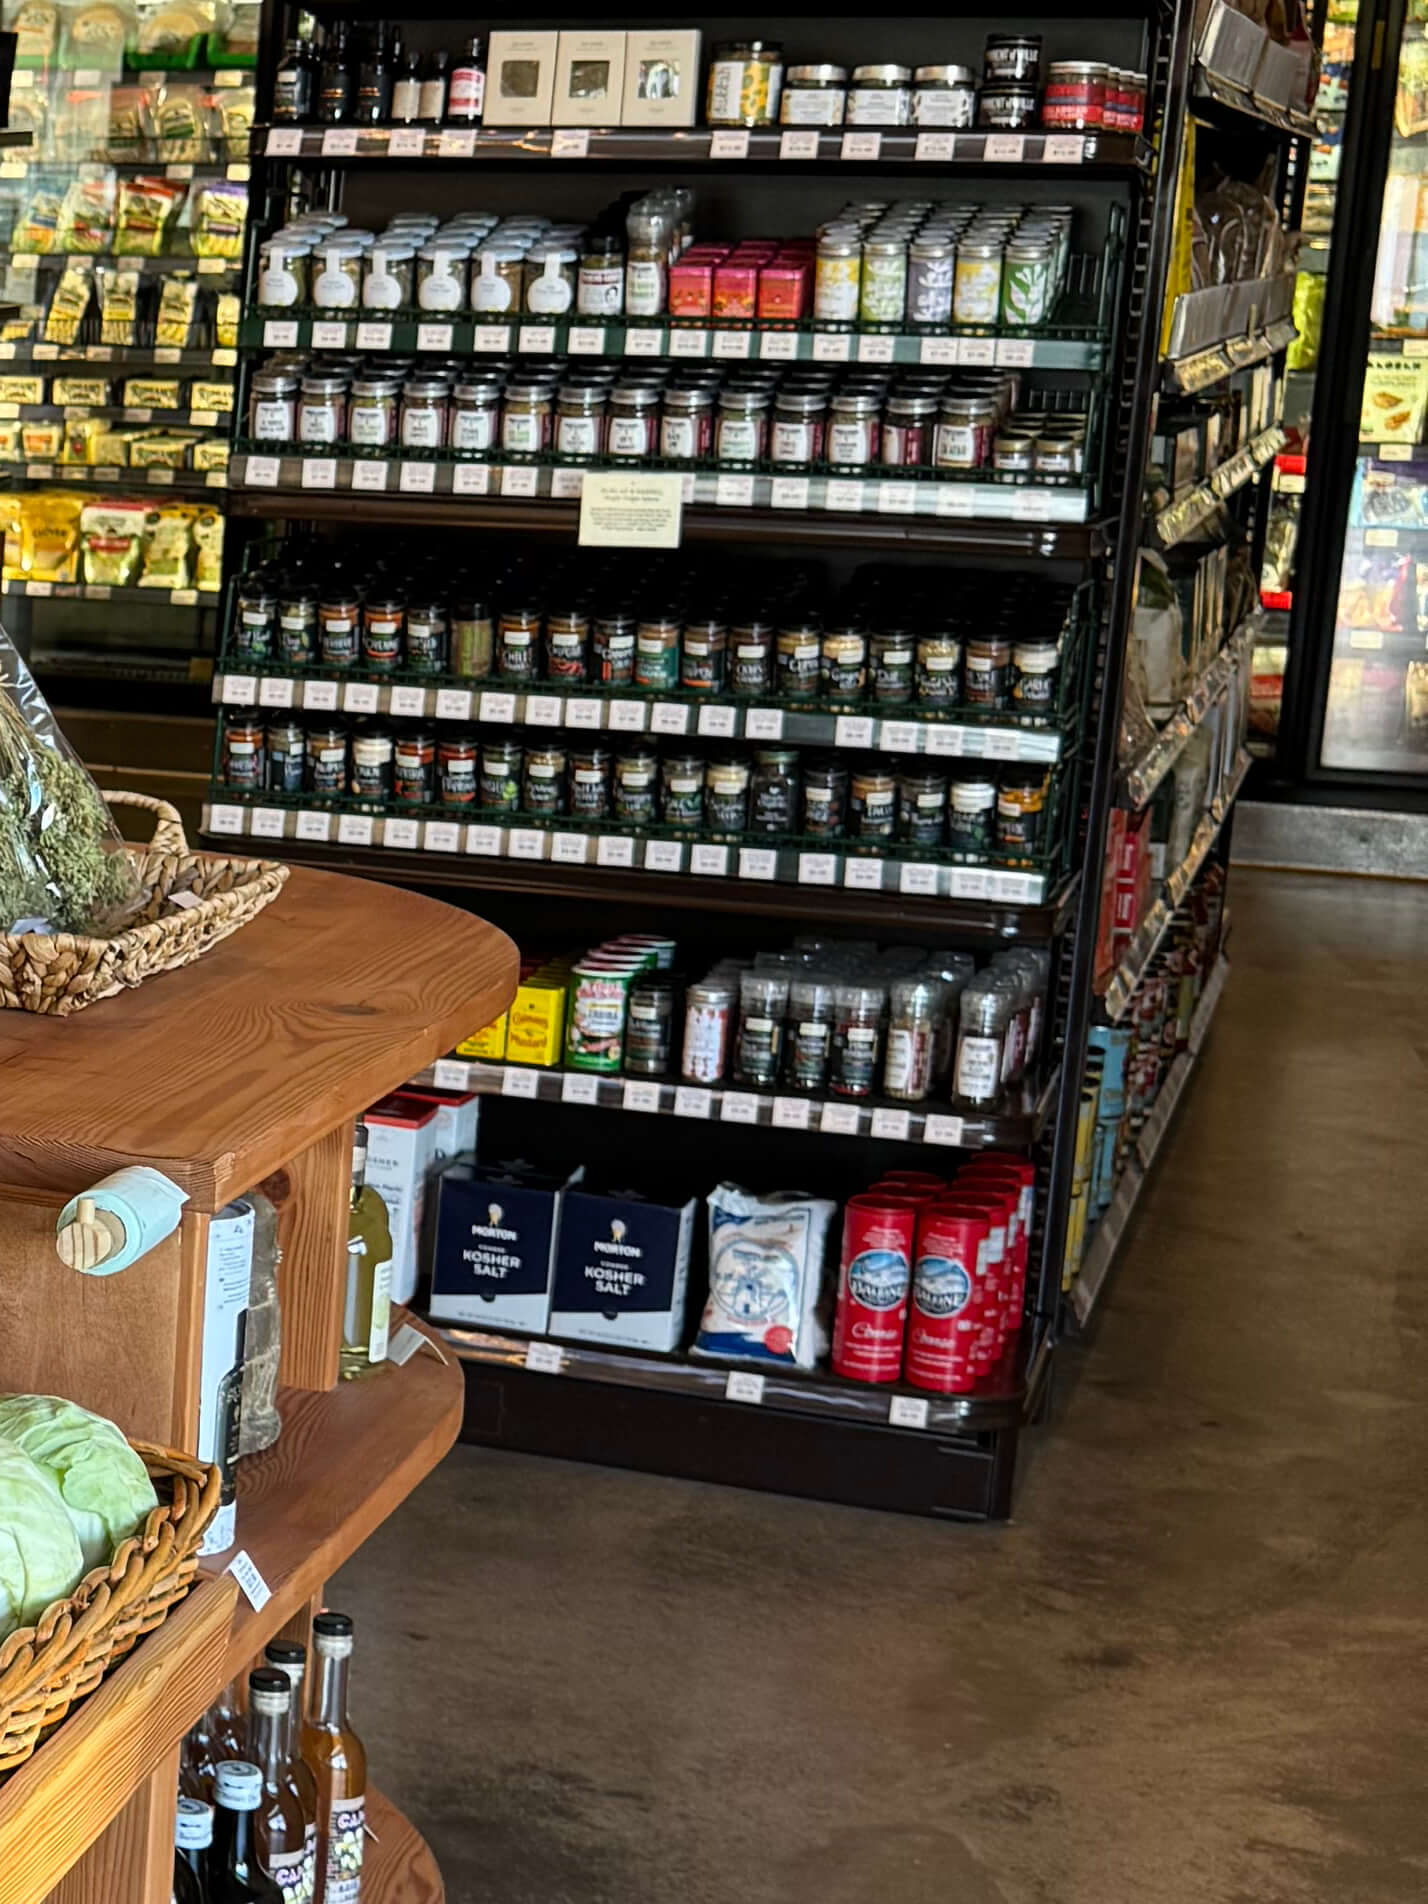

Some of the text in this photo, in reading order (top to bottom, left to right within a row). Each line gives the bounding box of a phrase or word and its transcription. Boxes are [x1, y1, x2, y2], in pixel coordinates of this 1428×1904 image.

[471, 1224, 518, 1242] MORTON
[593, 1240, 642, 1259] MORTON
[462, 1249, 521, 1269] KOSHER
[473, 1263, 508, 1279] SALT
[584, 1266, 645, 1286] KOSHER
[595, 1280, 632, 1296] SALT
